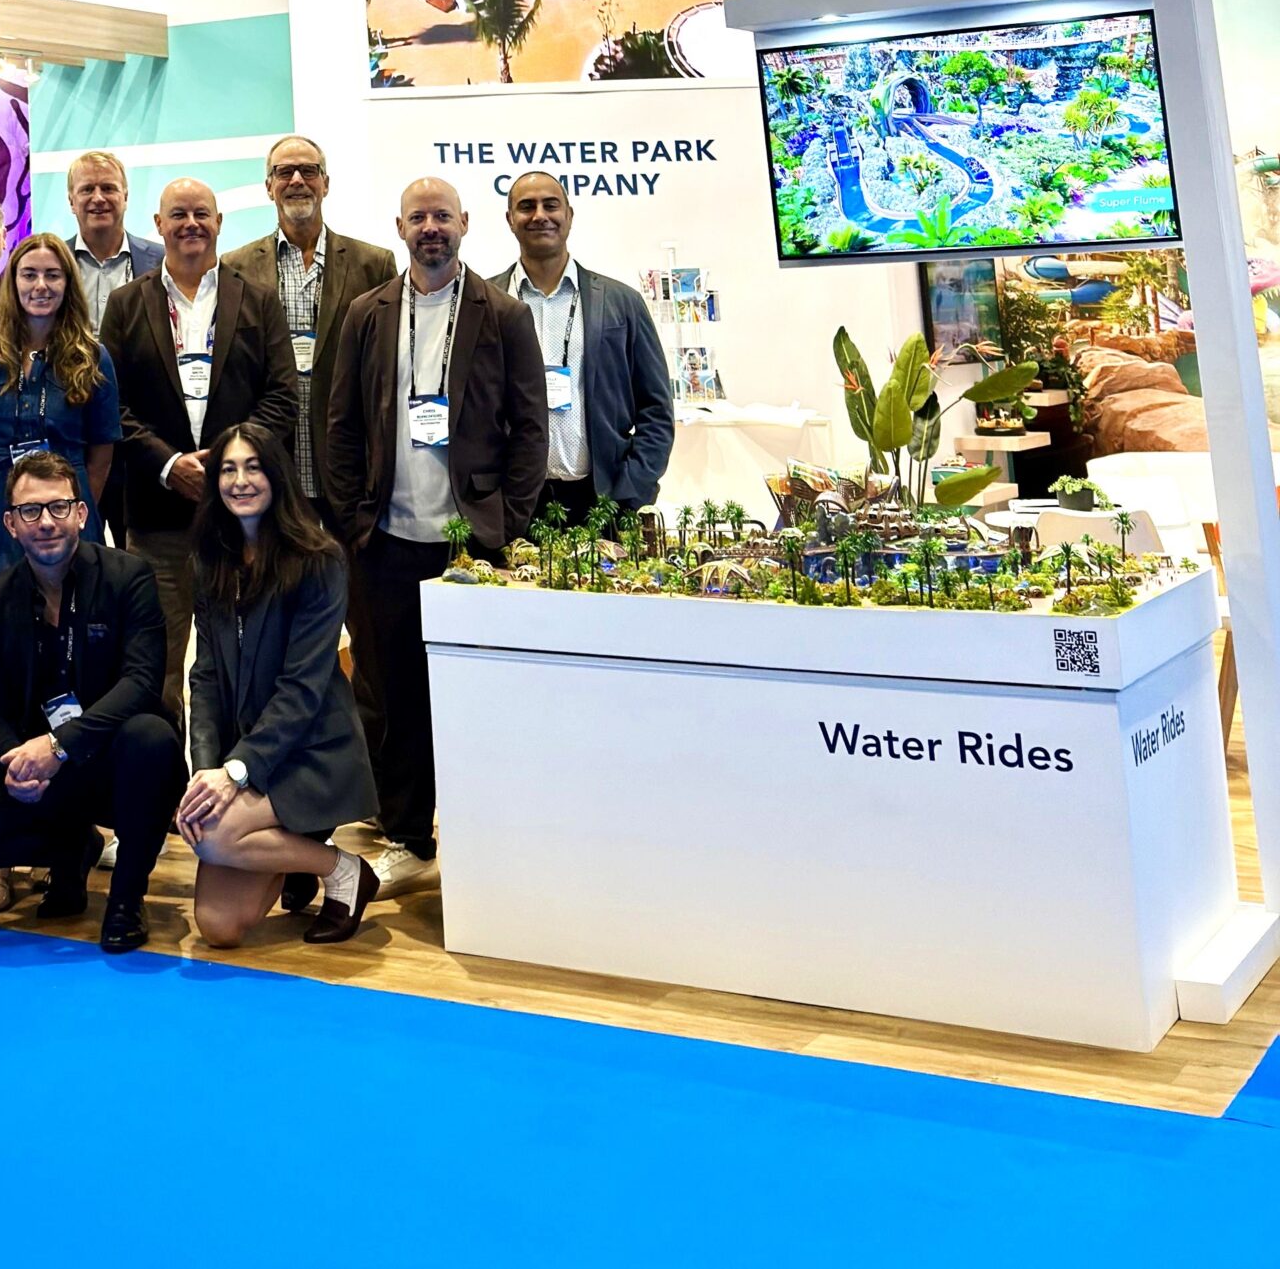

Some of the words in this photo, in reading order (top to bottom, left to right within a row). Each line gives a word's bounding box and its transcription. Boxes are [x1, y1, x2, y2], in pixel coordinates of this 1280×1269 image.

[433, 142, 495, 164] THE
[506, 141, 619, 164] WATER
[631, 139, 718, 163] PARK
[493, 173, 661, 197] CPANY
[1099, 198, 1131, 208] Super
[1133, 196, 1166, 206] Flume
[818, 721, 943, 762] Water
[957, 730, 1074, 773] Rides
[1131, 727, 1160, 768] Water
[1161, 703, 1186, 747] Rides
